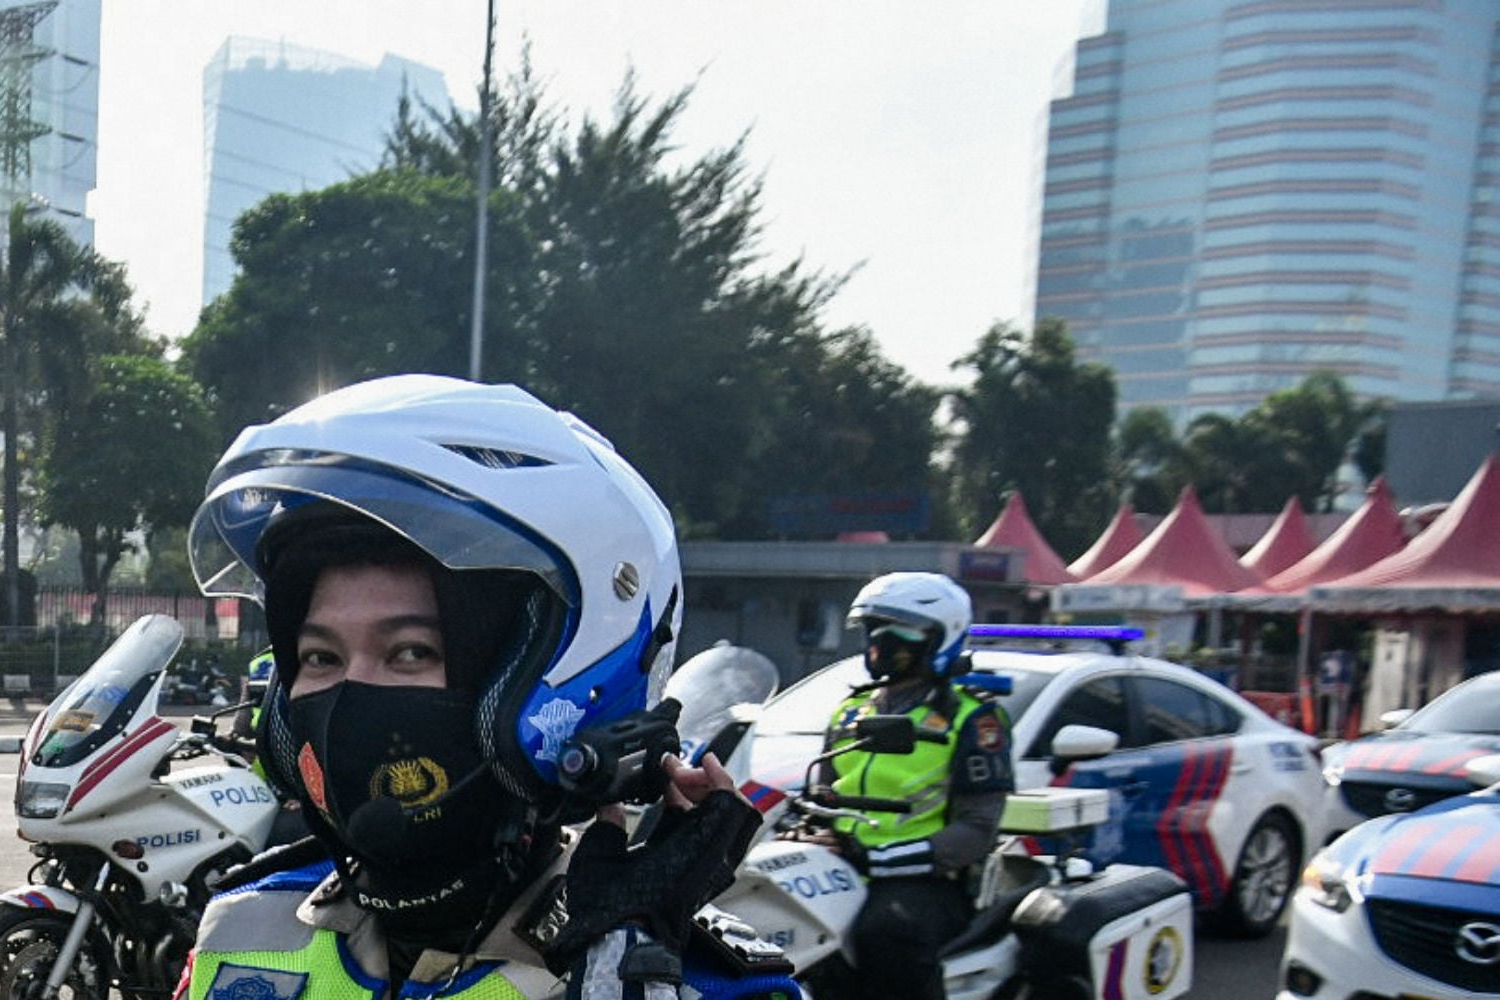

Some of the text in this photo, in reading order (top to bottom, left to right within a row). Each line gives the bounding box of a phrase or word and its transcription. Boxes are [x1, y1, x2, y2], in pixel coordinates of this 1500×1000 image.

[179, 773, 224, 791] YAMAHA
[209, 786, 274, 807] POLIS
[136, 828, 202, 848] POLISI
